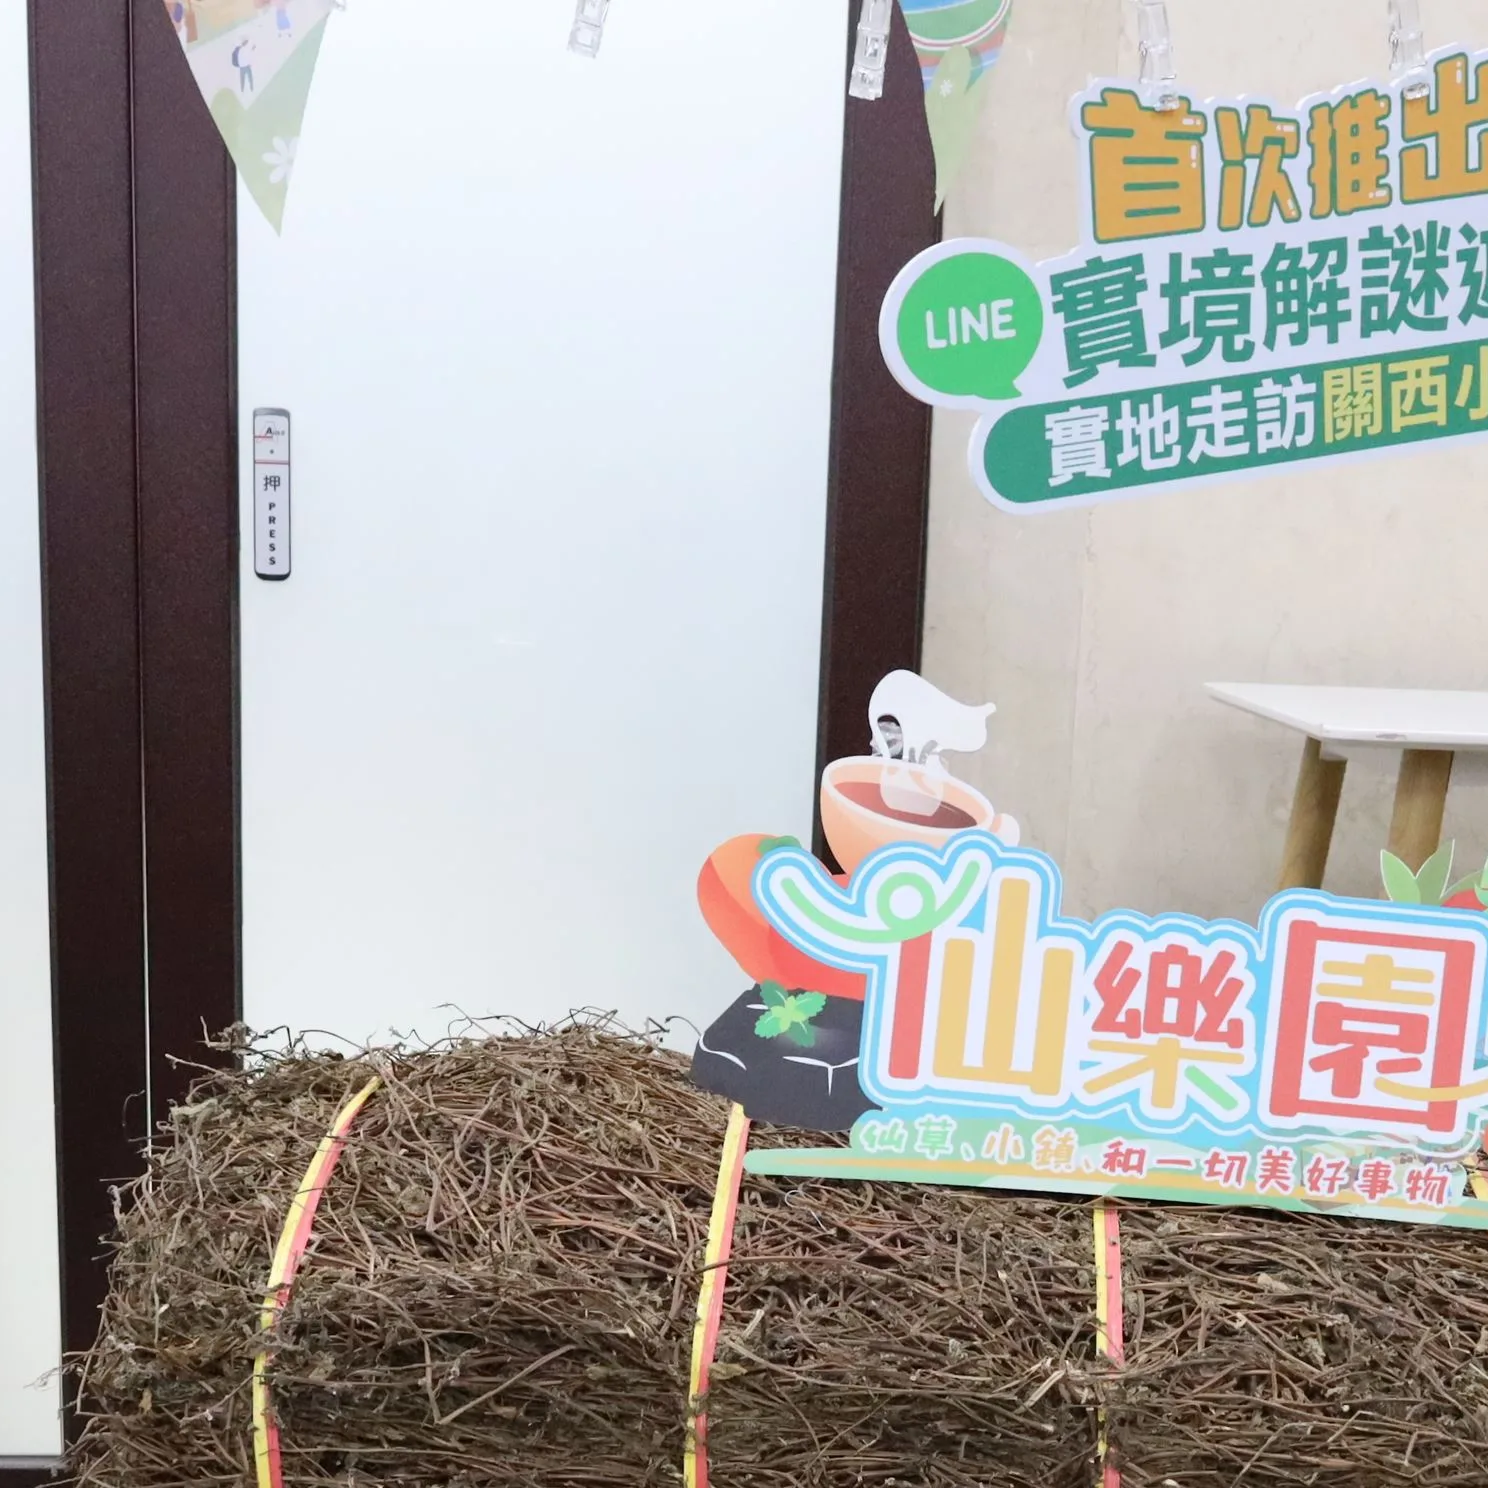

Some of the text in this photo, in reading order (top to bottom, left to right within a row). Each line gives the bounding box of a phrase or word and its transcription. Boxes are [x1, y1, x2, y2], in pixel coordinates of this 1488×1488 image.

[925, 298, 1017, 349] LINE
[263, 475, 281, 492] 押
[268, 502, 276, 565] PRESS
[862, 1114, 1452, 1207] 仙草、小鎮、和一切美好事物
